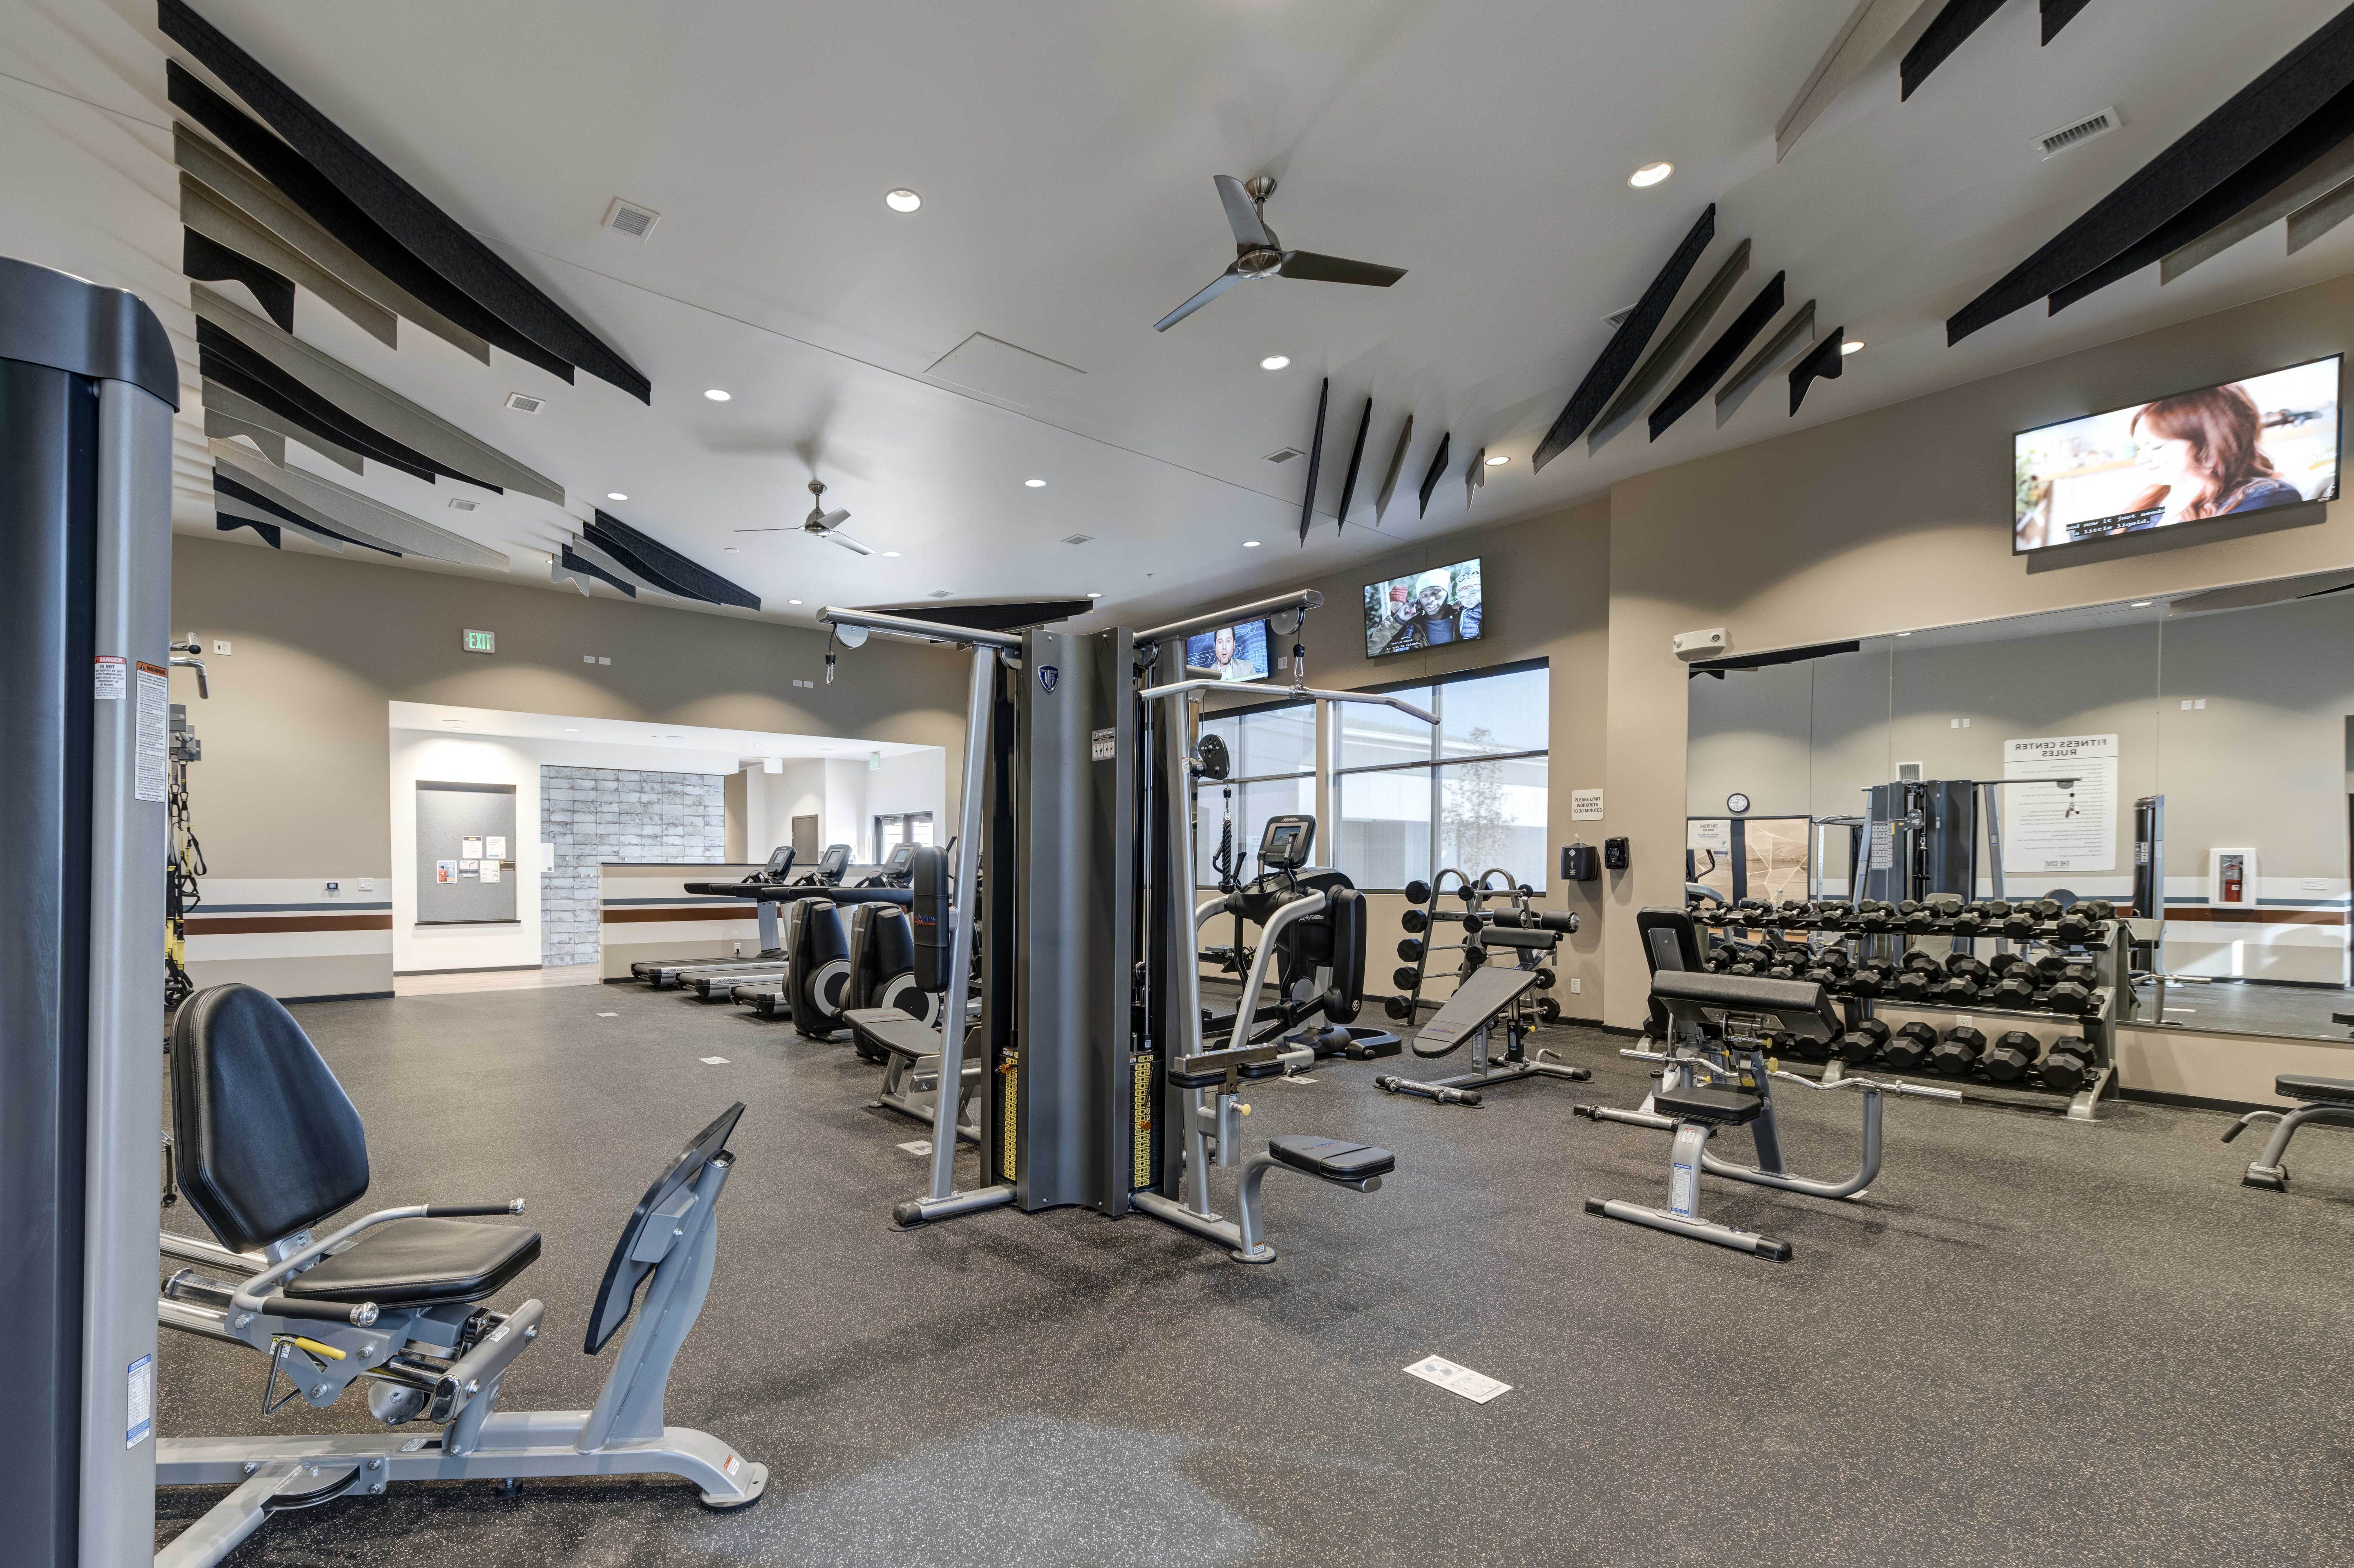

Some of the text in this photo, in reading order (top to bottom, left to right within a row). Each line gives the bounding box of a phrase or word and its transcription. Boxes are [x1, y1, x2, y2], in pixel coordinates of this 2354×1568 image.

[2140, 508, 2165, 517] needs
[2084, 526, 2112, 534] little
[2117, 519, 2150, 528] liquid,
[469, 632, 491, 650] EXIT
[147, 666, 166, 675] WARNING
